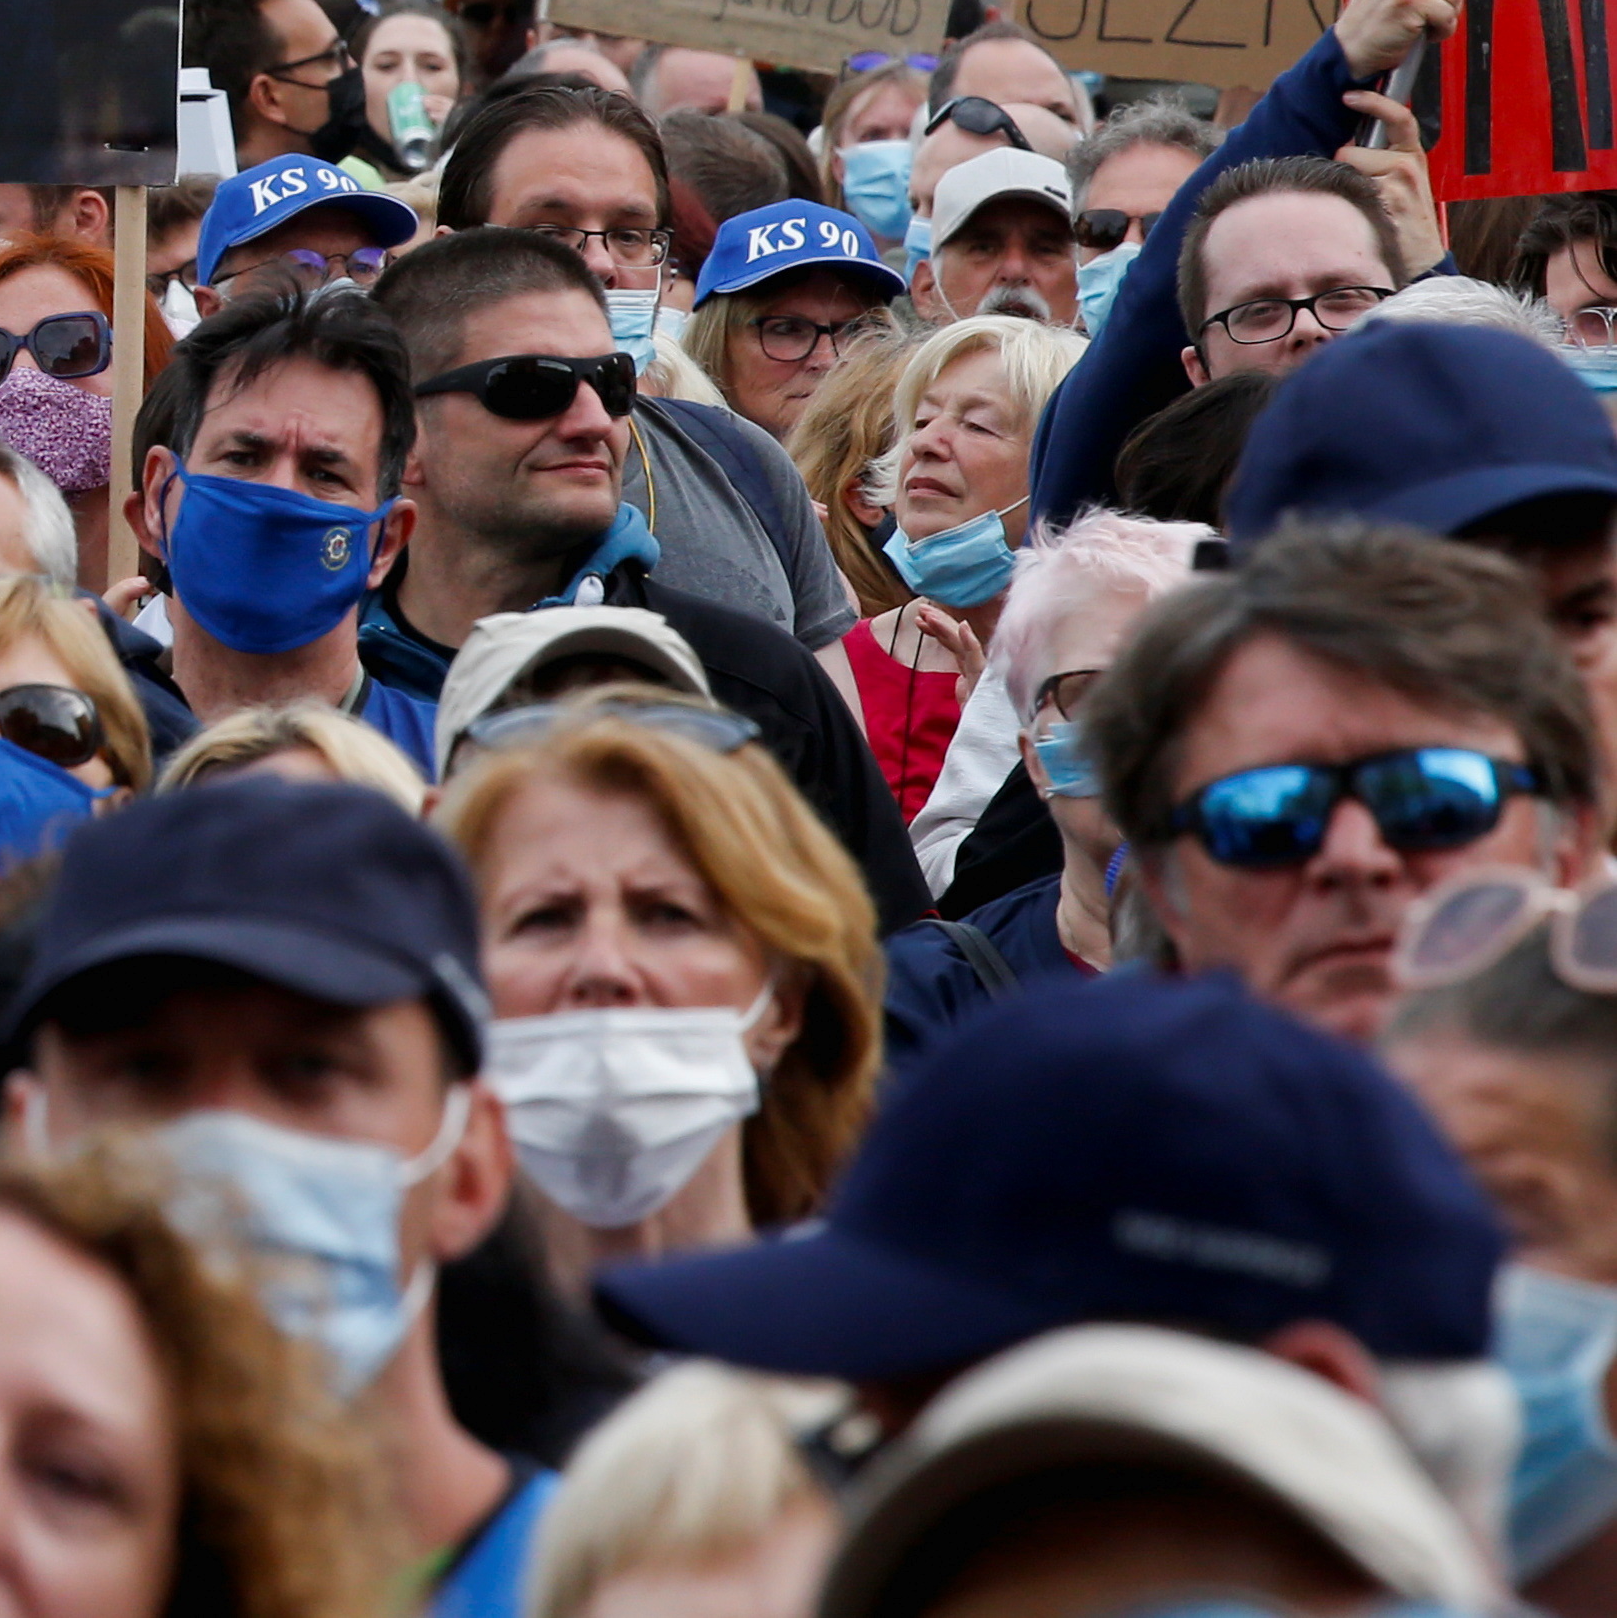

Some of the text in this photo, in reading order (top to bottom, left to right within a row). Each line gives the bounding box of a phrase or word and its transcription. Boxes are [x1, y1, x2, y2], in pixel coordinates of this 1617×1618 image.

[249, 166, 357, 214] KS 90
[747, 218, 859, 263] KS 90
